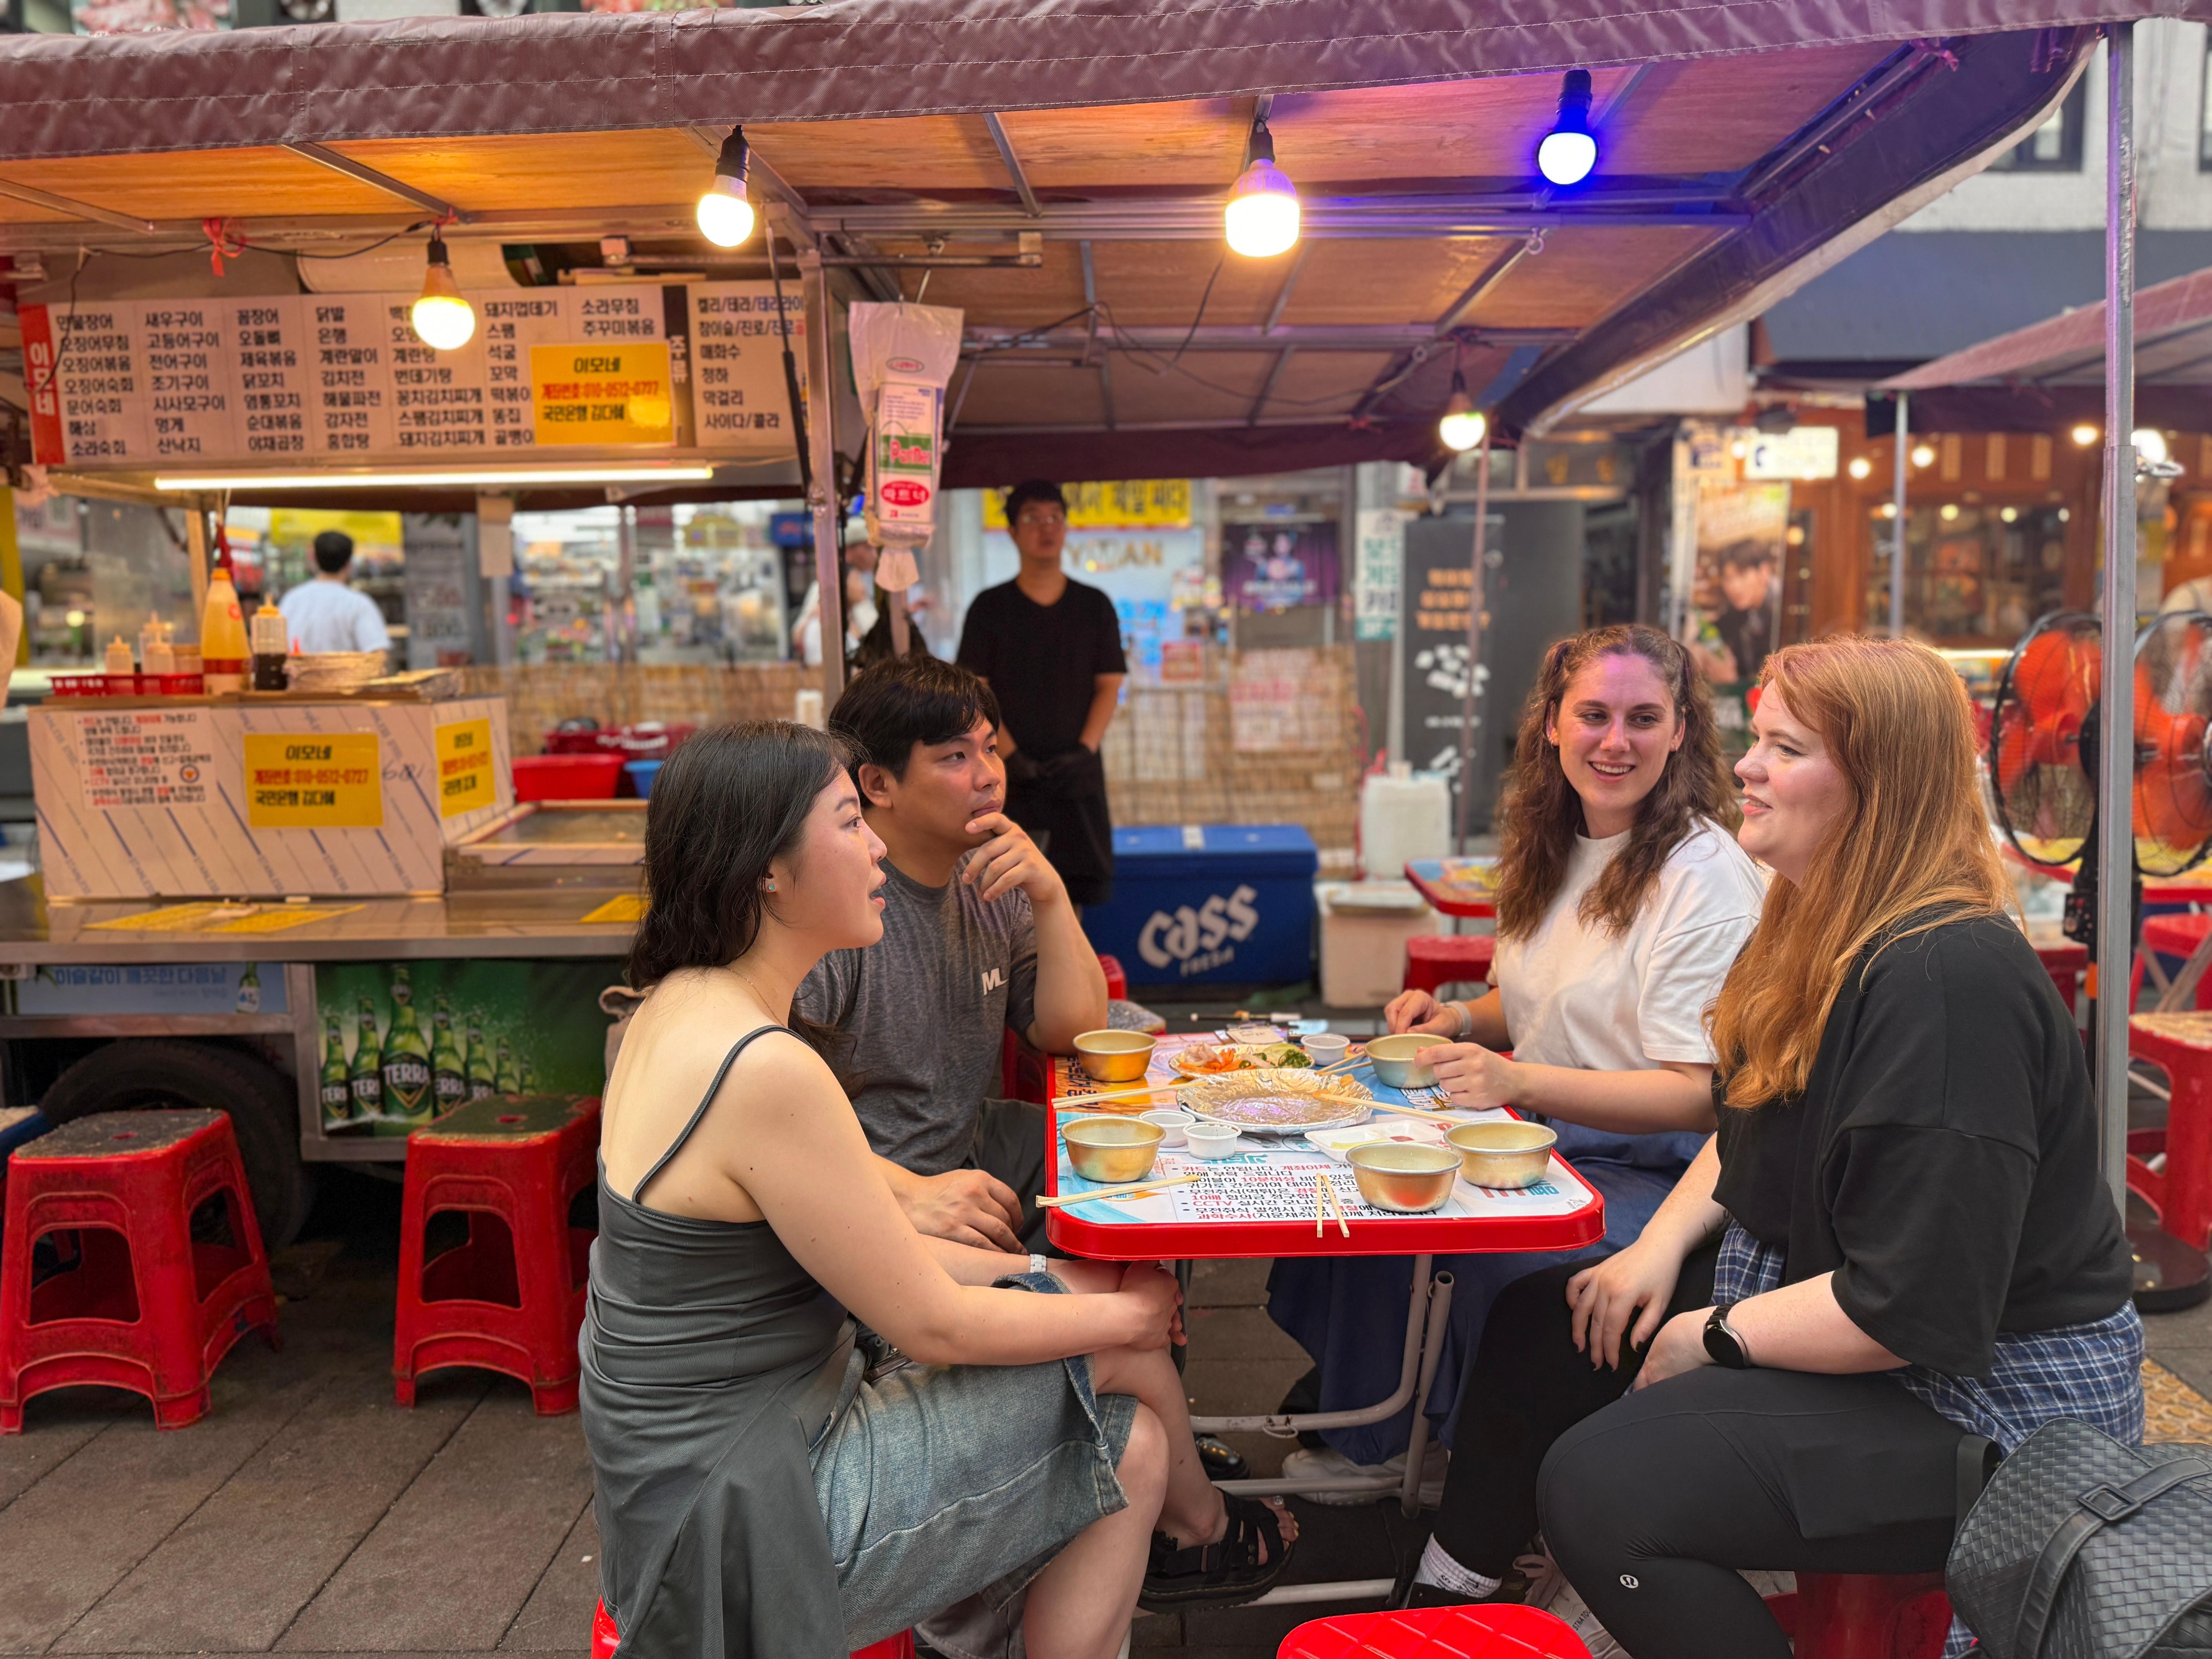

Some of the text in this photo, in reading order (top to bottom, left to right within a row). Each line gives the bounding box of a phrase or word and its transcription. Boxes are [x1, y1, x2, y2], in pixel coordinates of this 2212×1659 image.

[582, 298, 639, 313] 소라무침
[145, 311, 203, 328] 새우구이
[316, 307, 344, 322] 닭발
[318, 328, 346, 344] 은행
[583, 319, 655, 337] 주꾸미볶음
[62, 335, 129, 352] 오징어무침
[148, 333, 219, 349] 고등어구이
[241, 351, 296, 367] 제육볶음
[319, 349, 378, 365] 계란말이
[701, 345, 740, 360] 매화수
[63, 356, 131, 373] 오징어볶음
[149, 354, 207, 370] 전어구이
[574, 357, 621, 374] 이모네
[242, 372, 284, 389] 닭꼬치
[322, 370, 364, 386] 김치전
[395, 369, 452, 385] 번데기탕
[702, 367, 728, 383] 청하
[65, 378, 133, 394] 오징어숙회
[152, 375, 209, 392] 조기구이
[67, 398, 122, 415] 문어숙회
[154, 396, 225, 412] 시사모구이
[324, 391, 381, 407] 해물파전
[704, 391, 743, 406] 막걸리
[156, 417, 184, 434] 멍게
[247, 414, 302, 431] 순대볶음
[326, 412, 368, 428] 감자전
[72, 439, 126, 457] 소라숙회
[157, 438, 201, 455] 산낙지
[249, 436, 303, 452] 야채곱창
[328, 434, 369, 450] 홍합탕
[285, 745, 333, 760] 이모네
